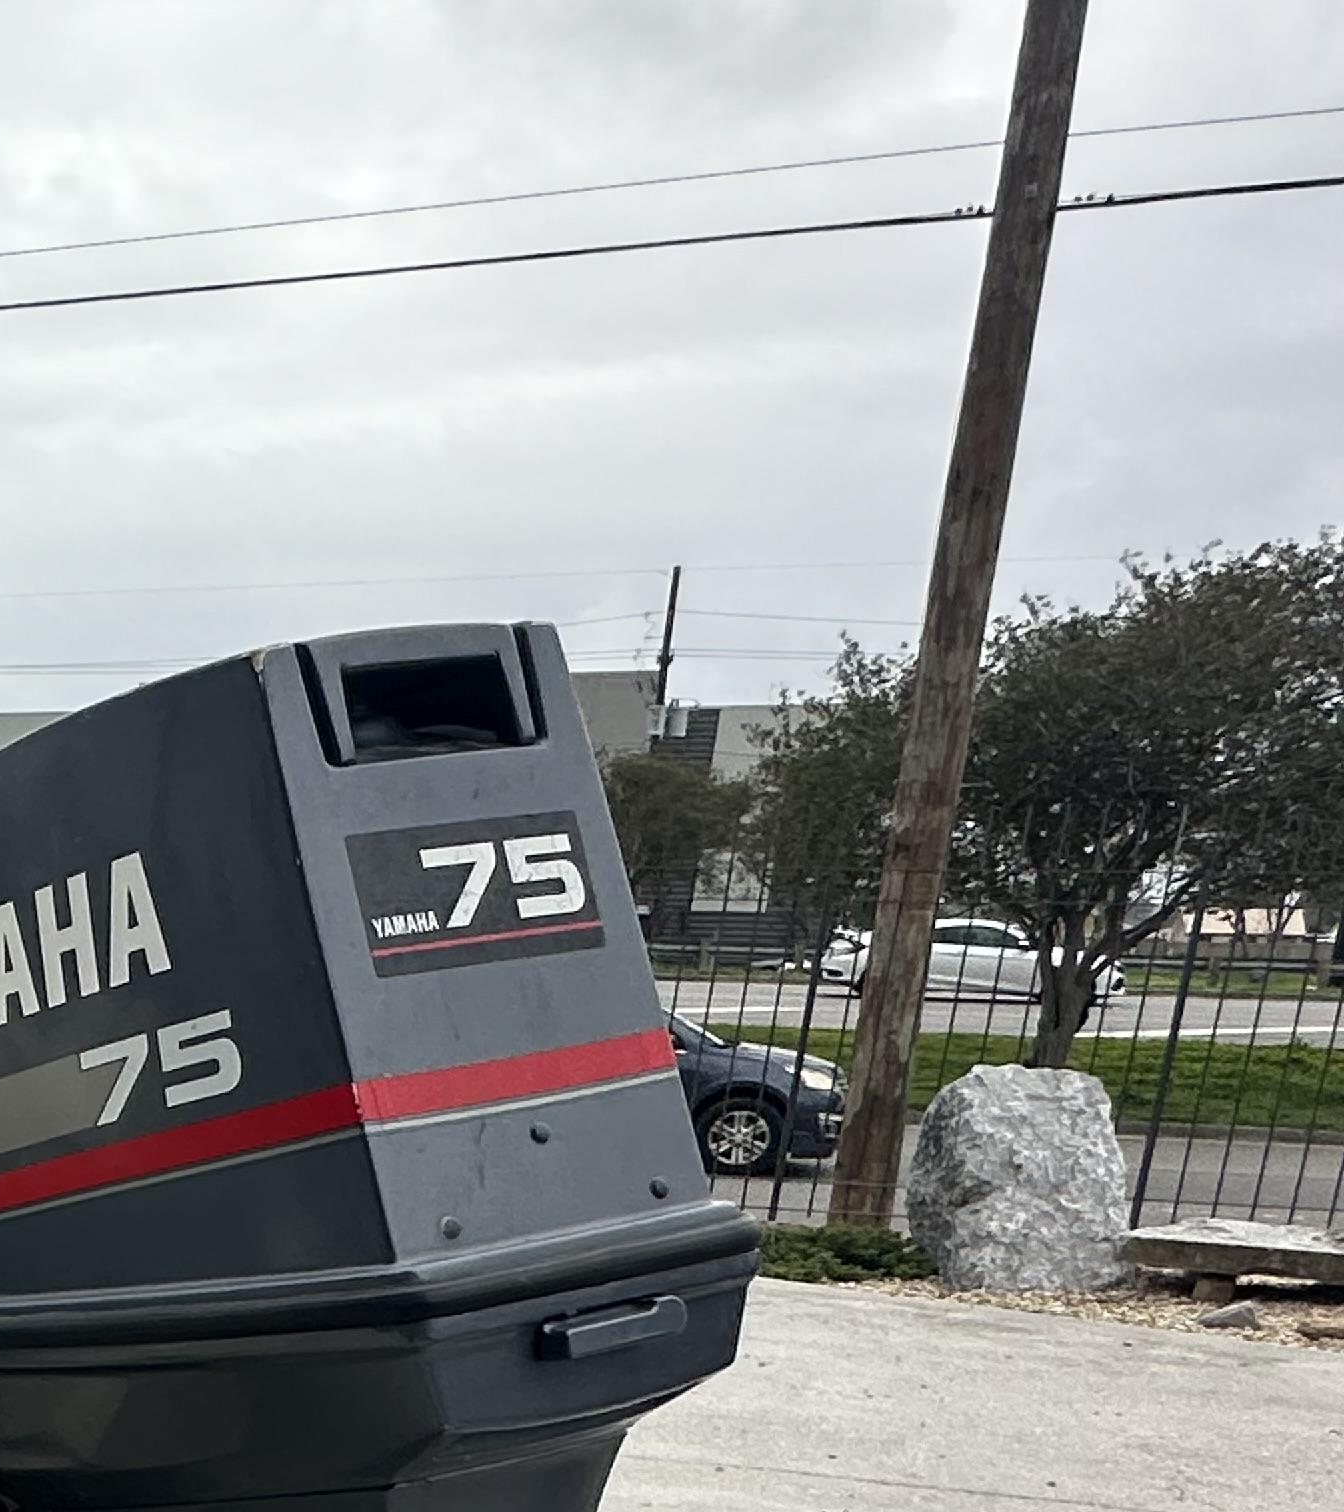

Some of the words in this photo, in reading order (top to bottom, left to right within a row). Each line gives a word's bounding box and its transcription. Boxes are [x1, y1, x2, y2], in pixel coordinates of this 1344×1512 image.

[370, 910, 440, 938] YAMAHA
[418, 833, 586, 929] 75
[78, 1008, 243, 1128] 75
